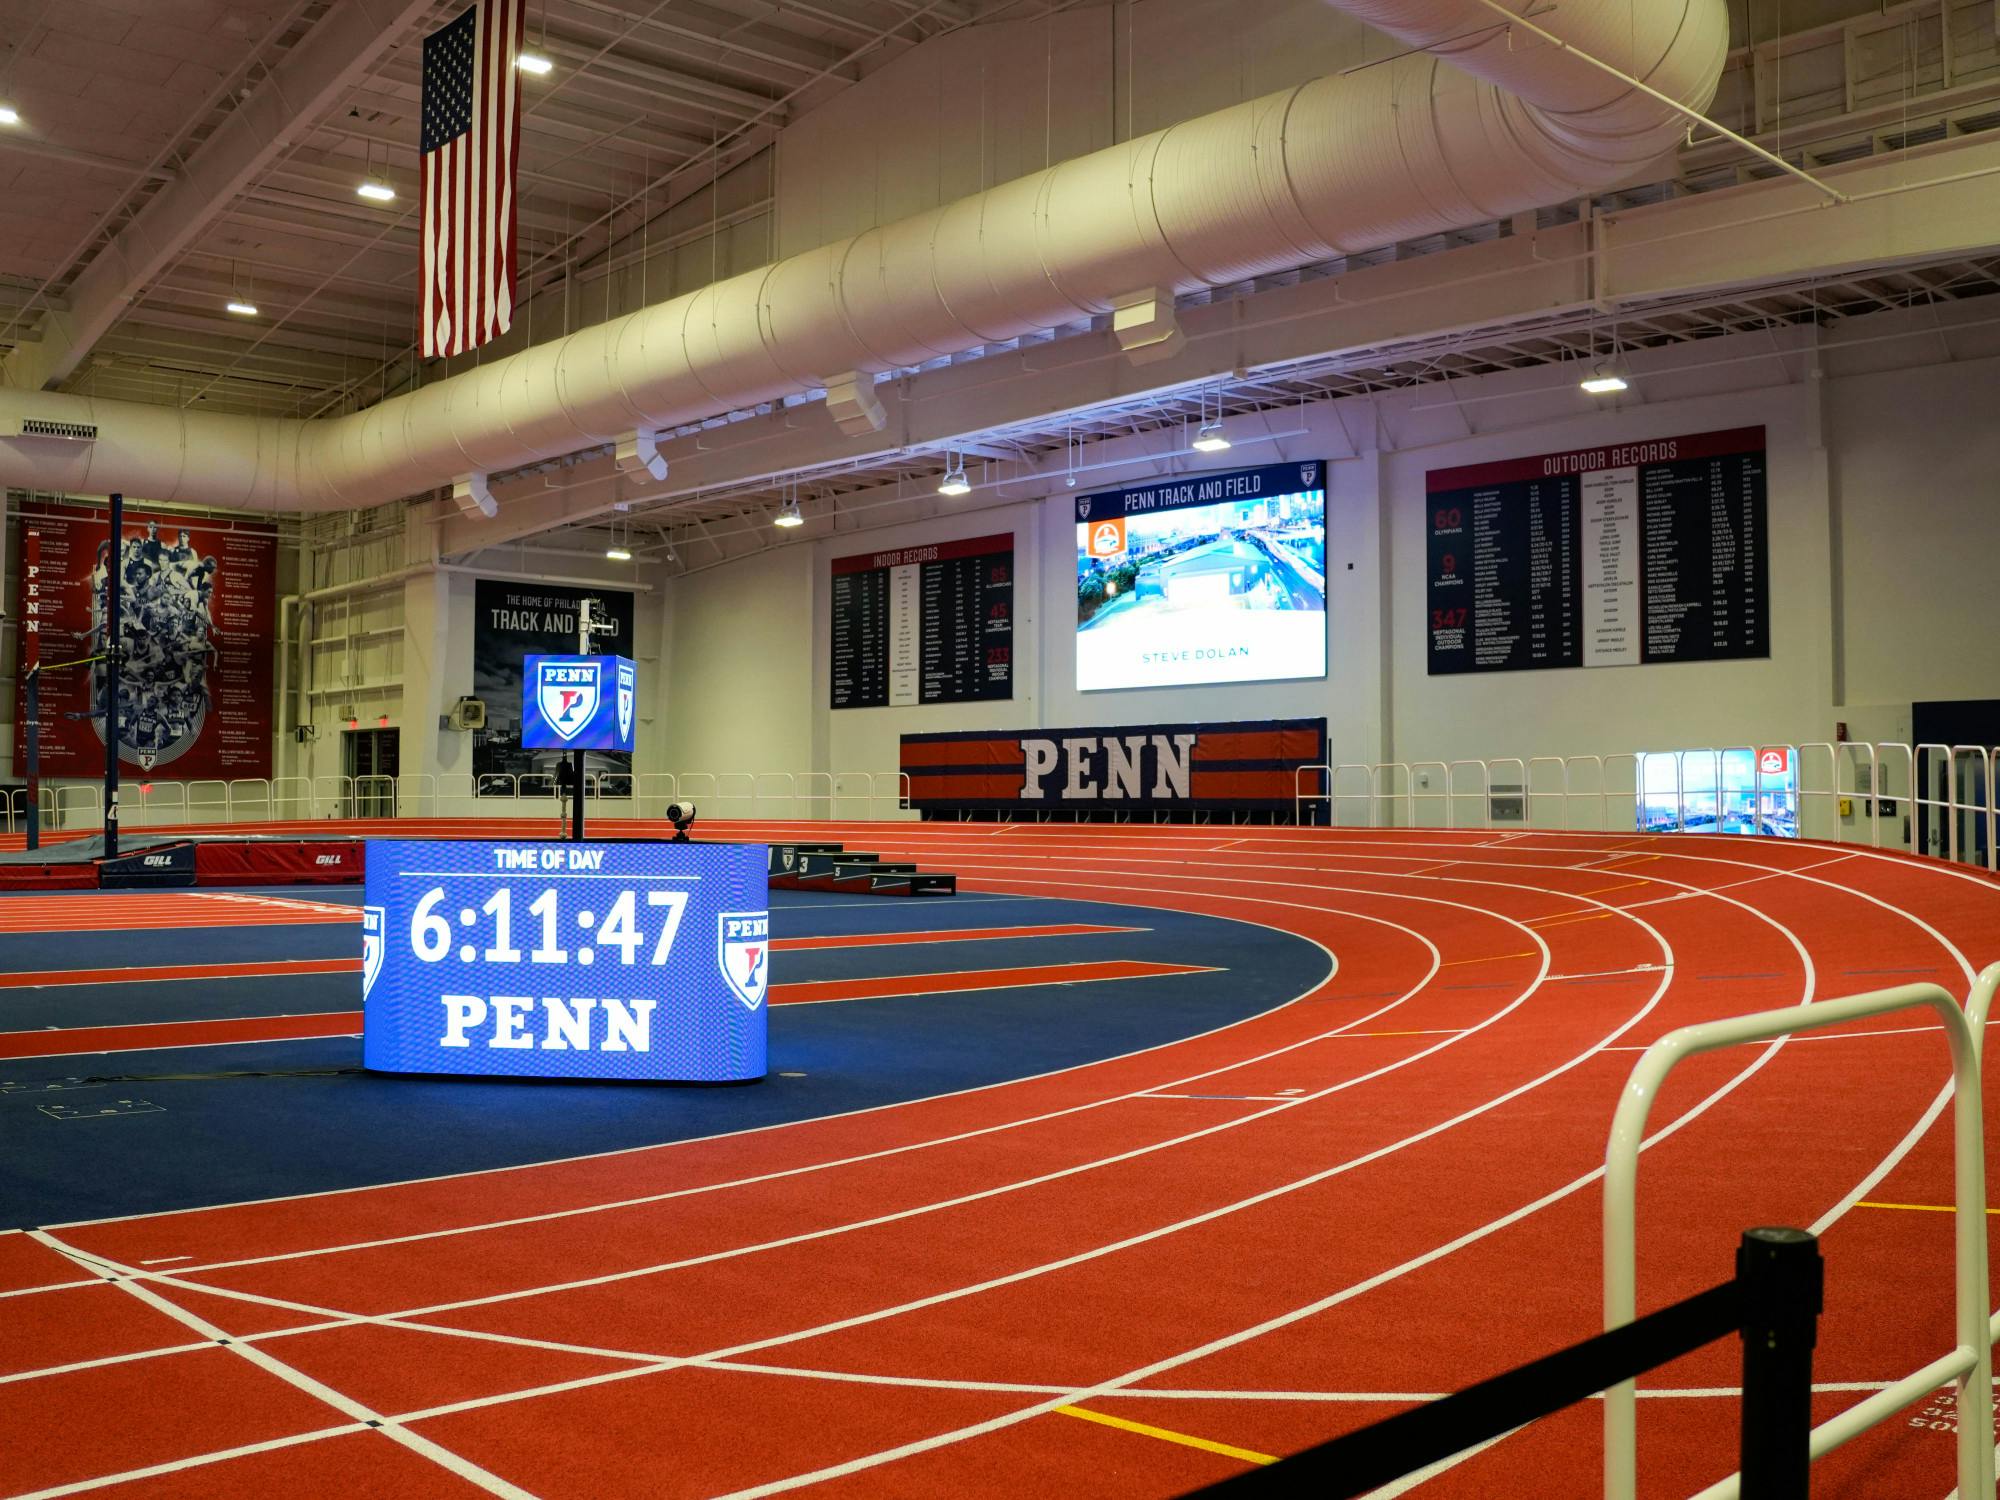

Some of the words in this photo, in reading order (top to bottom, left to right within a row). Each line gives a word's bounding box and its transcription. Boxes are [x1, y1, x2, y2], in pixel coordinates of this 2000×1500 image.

[1543, 451, 1606, 476] OUTDOOR
[1612, 441, 1677, 467] RECORDS
[1124, 492, 1155, 511] PENN
[1158, 485, 1195, 506] TRACK
[1198, 482, 1222, 500] AND
[1226, 475, 1261, 496] FIELD
[1434, 507, 1462, 528] 60
[1434, 527, 1463, 536] OLYMPIANS
[873, 553, 901, 568] INDOOR
[904, 547, 938, 564] RECORDS
[1442, 553, 1456, 573] 9
[1434, 579, 1464, 587] CHAMPIONS
[506, 594, 521, 606] THE
[522, 596, 542, 607] HOME
[544, 597, 553, 608] OF
[491, 609, 540, 631] TRACK
[543, 613, 574, 634] AND
[1432, 607, 1467, 630] 347
[1143, 650, 1189, 664] STEVE
[1196, 647, 1249, 659] DOLAN
[544, 668, 595, 682] PENN
[1020, 734, 1196, 799] PENN
[143, 856, 172, 865] GILL
[315, 855, 342, 864] GILL
[493, 848, 538, 869] TIME
[541, 849, 565, 869] OF
[568, 850, 605, 870] DAY
[800, 856, 809, 873] 3
[835, 867, 841, 877] 5
[872, 877, 878, 887] 7
[410, 886, 689, 966] 6:11:47
[440, 994, 657, 1052] PENN
